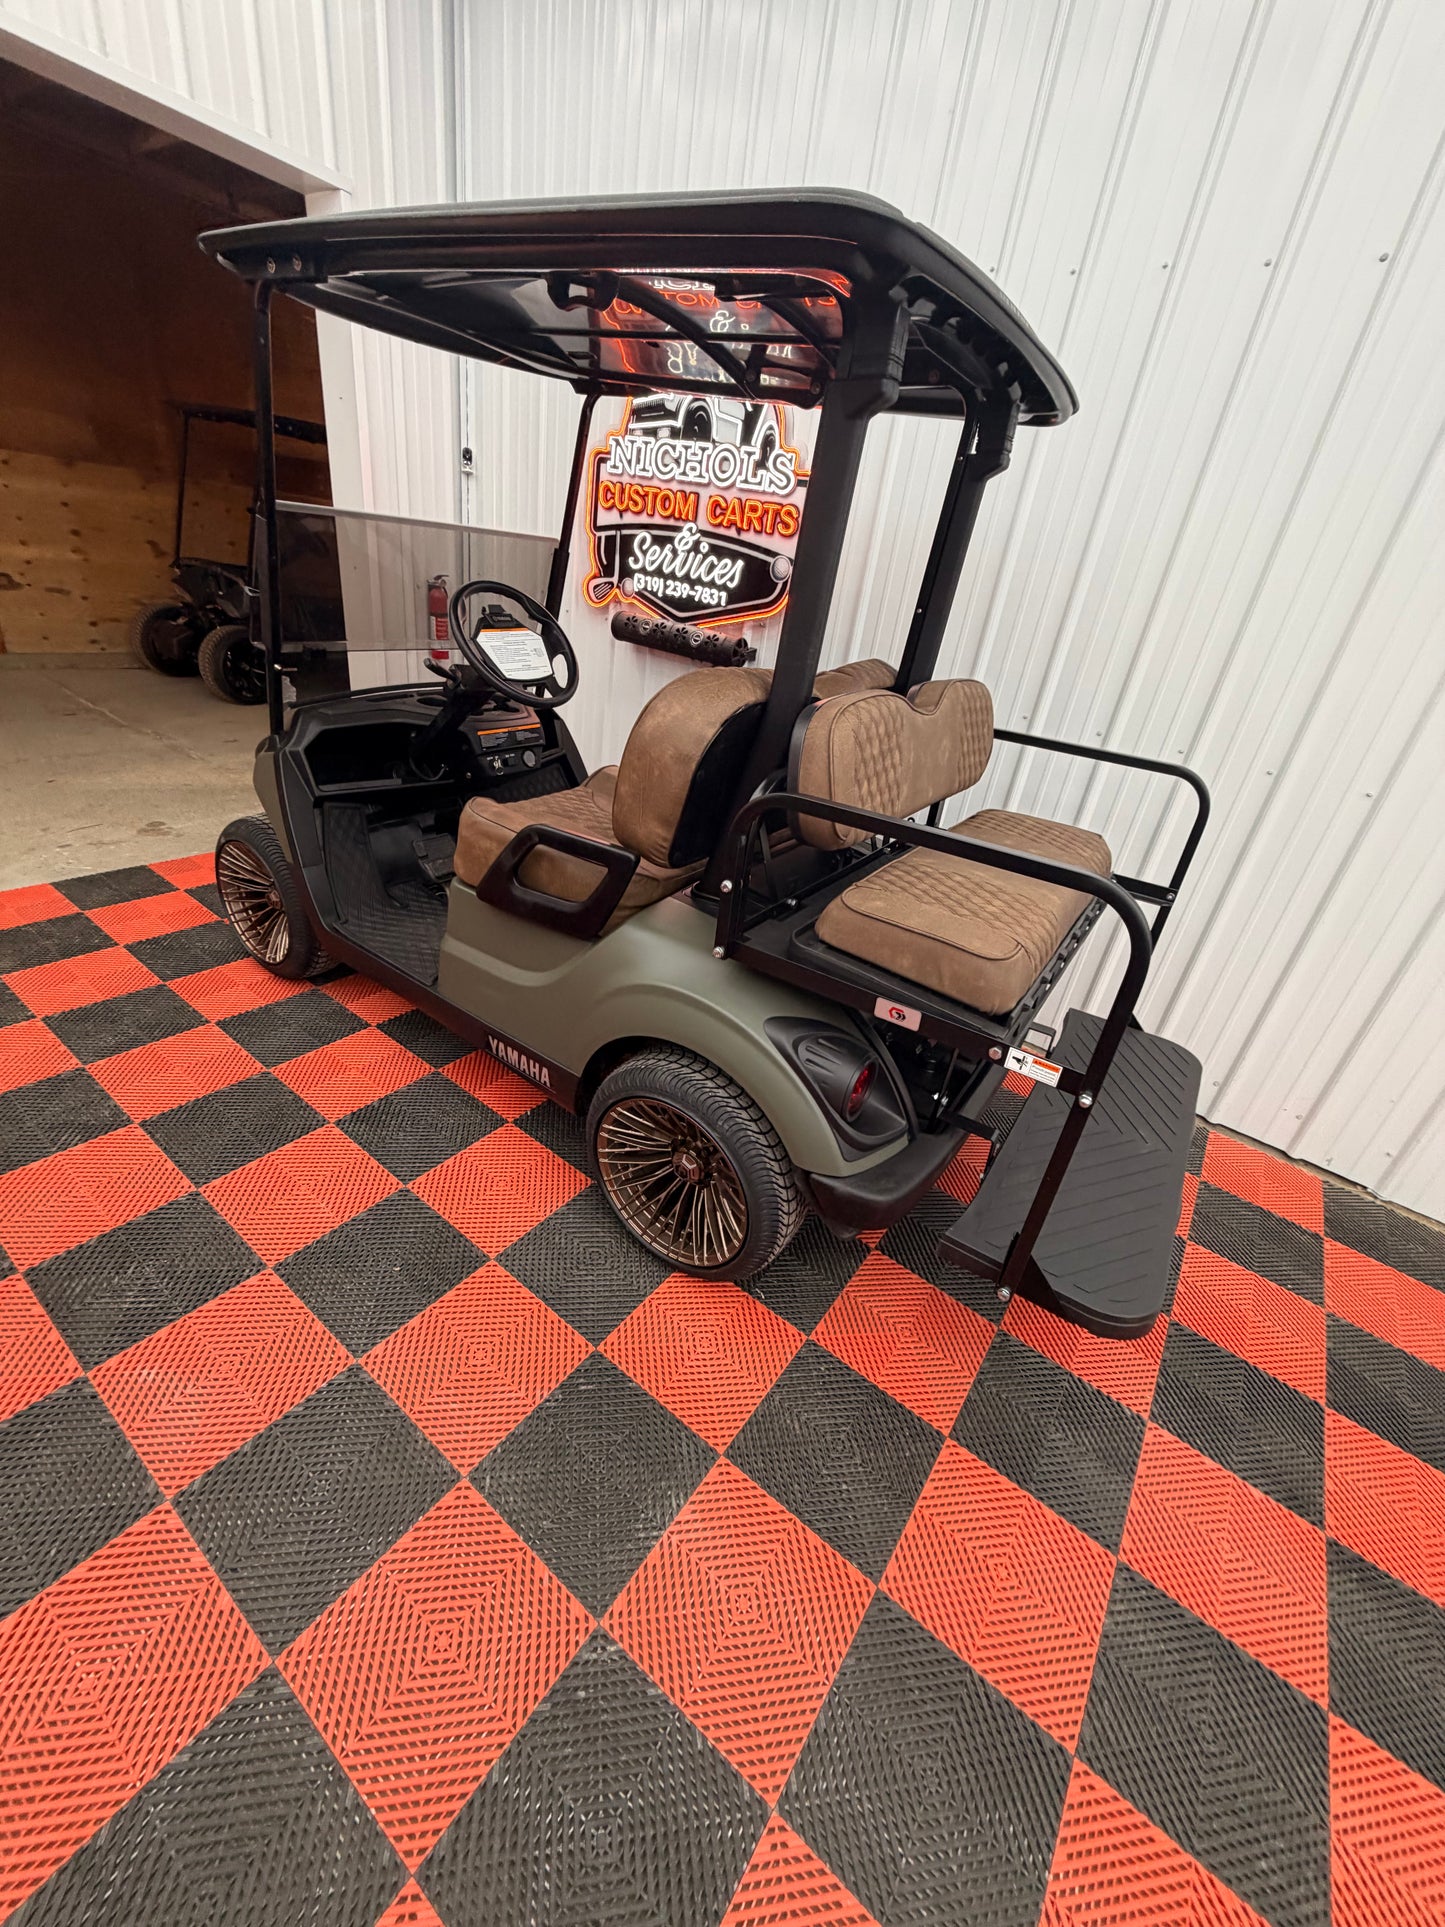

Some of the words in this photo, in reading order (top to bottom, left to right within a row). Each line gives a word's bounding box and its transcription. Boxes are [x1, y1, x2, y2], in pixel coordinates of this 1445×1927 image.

[607, 436, 796, 495] NICHOLS
[599, 480, 699, 521] CUSTOM
[706, 494, 800, 536] CARTS
[628, 531, 745, 588] Services
[674, 522, 701, 550] &
[633, 573, 663, 597] (319)
[665, 580, 727, 606] 239-7831
[487, 1034, 551, 1088] YAMAHA
